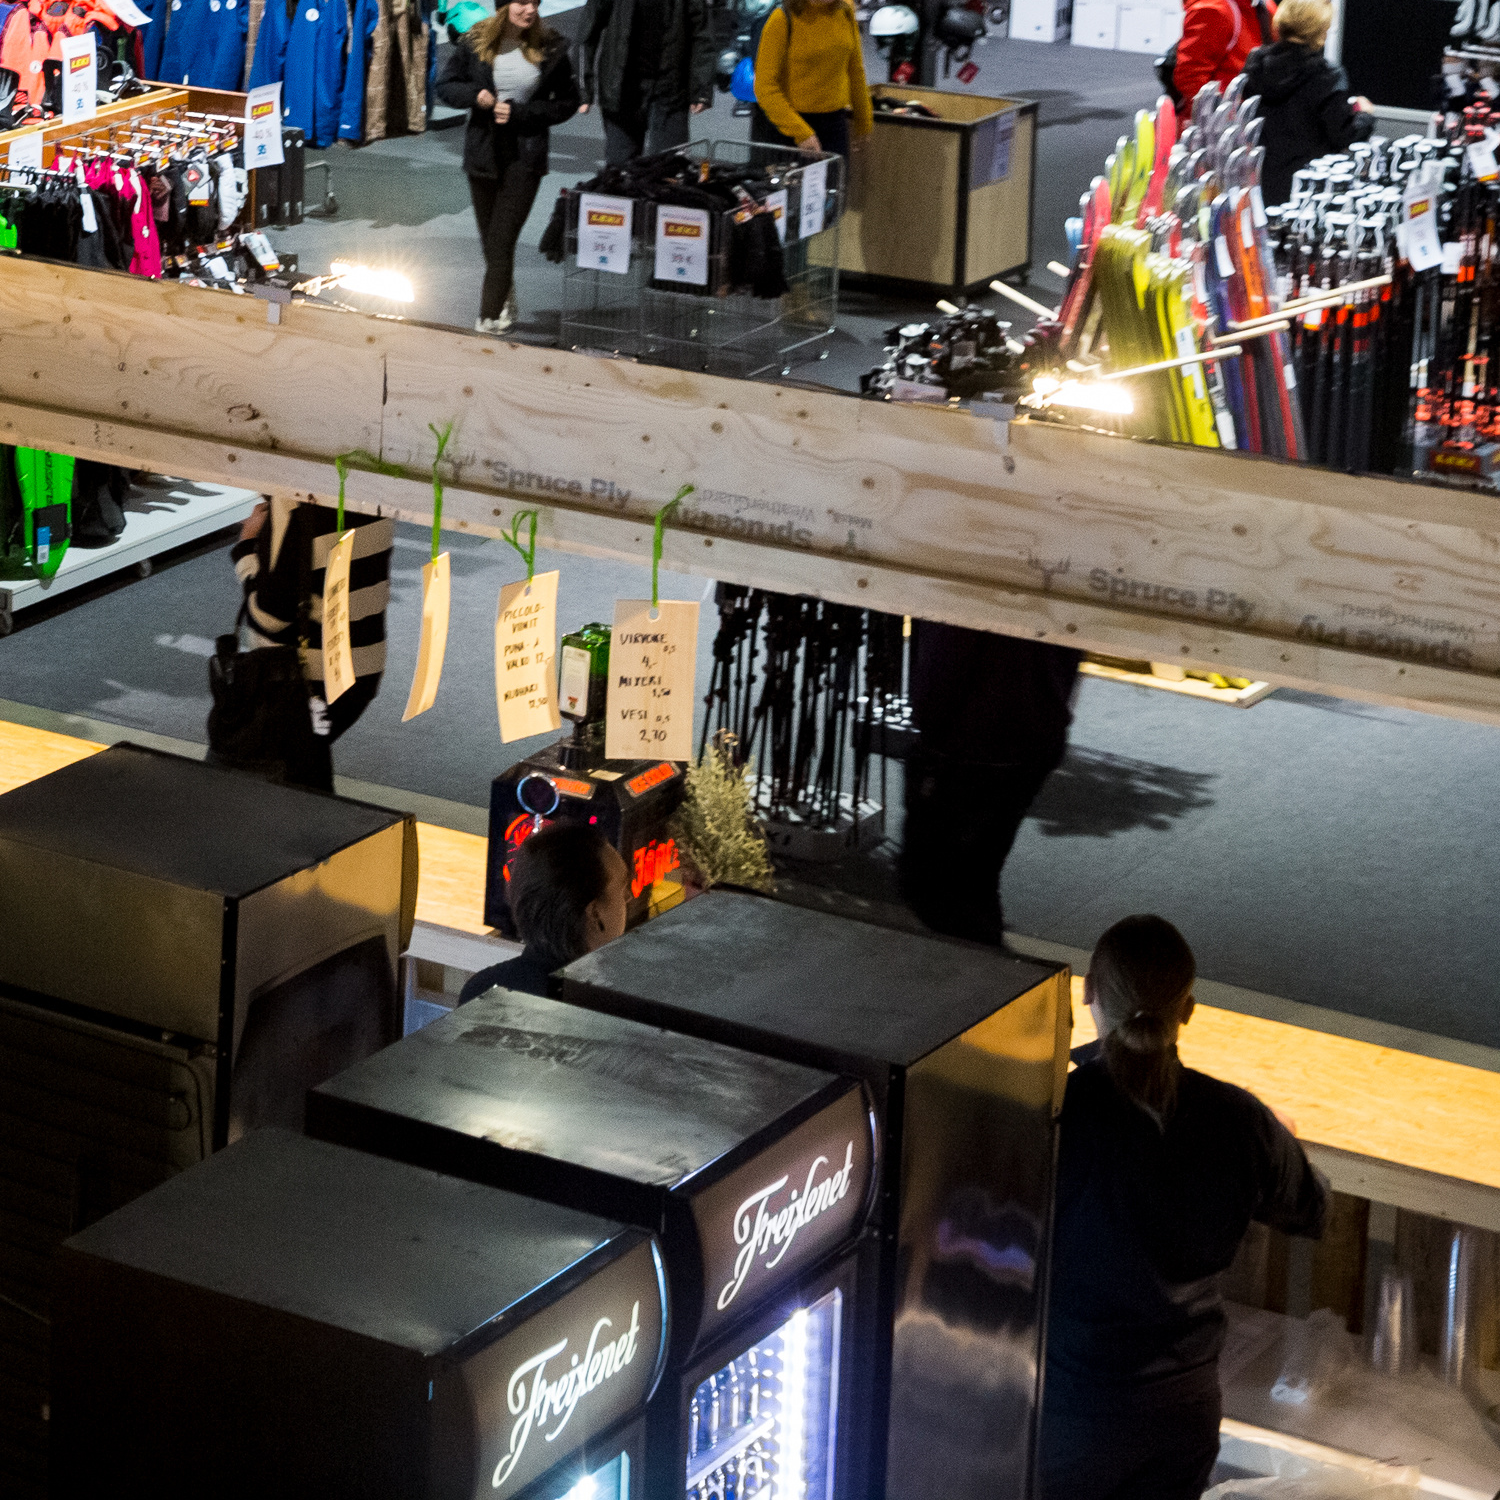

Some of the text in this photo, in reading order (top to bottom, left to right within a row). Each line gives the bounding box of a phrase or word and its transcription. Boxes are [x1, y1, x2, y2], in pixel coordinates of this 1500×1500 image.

[489, 459, 633, 508] Spruce Ply
[1088, 566, 1257, 624] Spruce Ply
[716, 1140, 853, 1311] Freixenet
[491, 1300, 641, 1488] Freixenet
